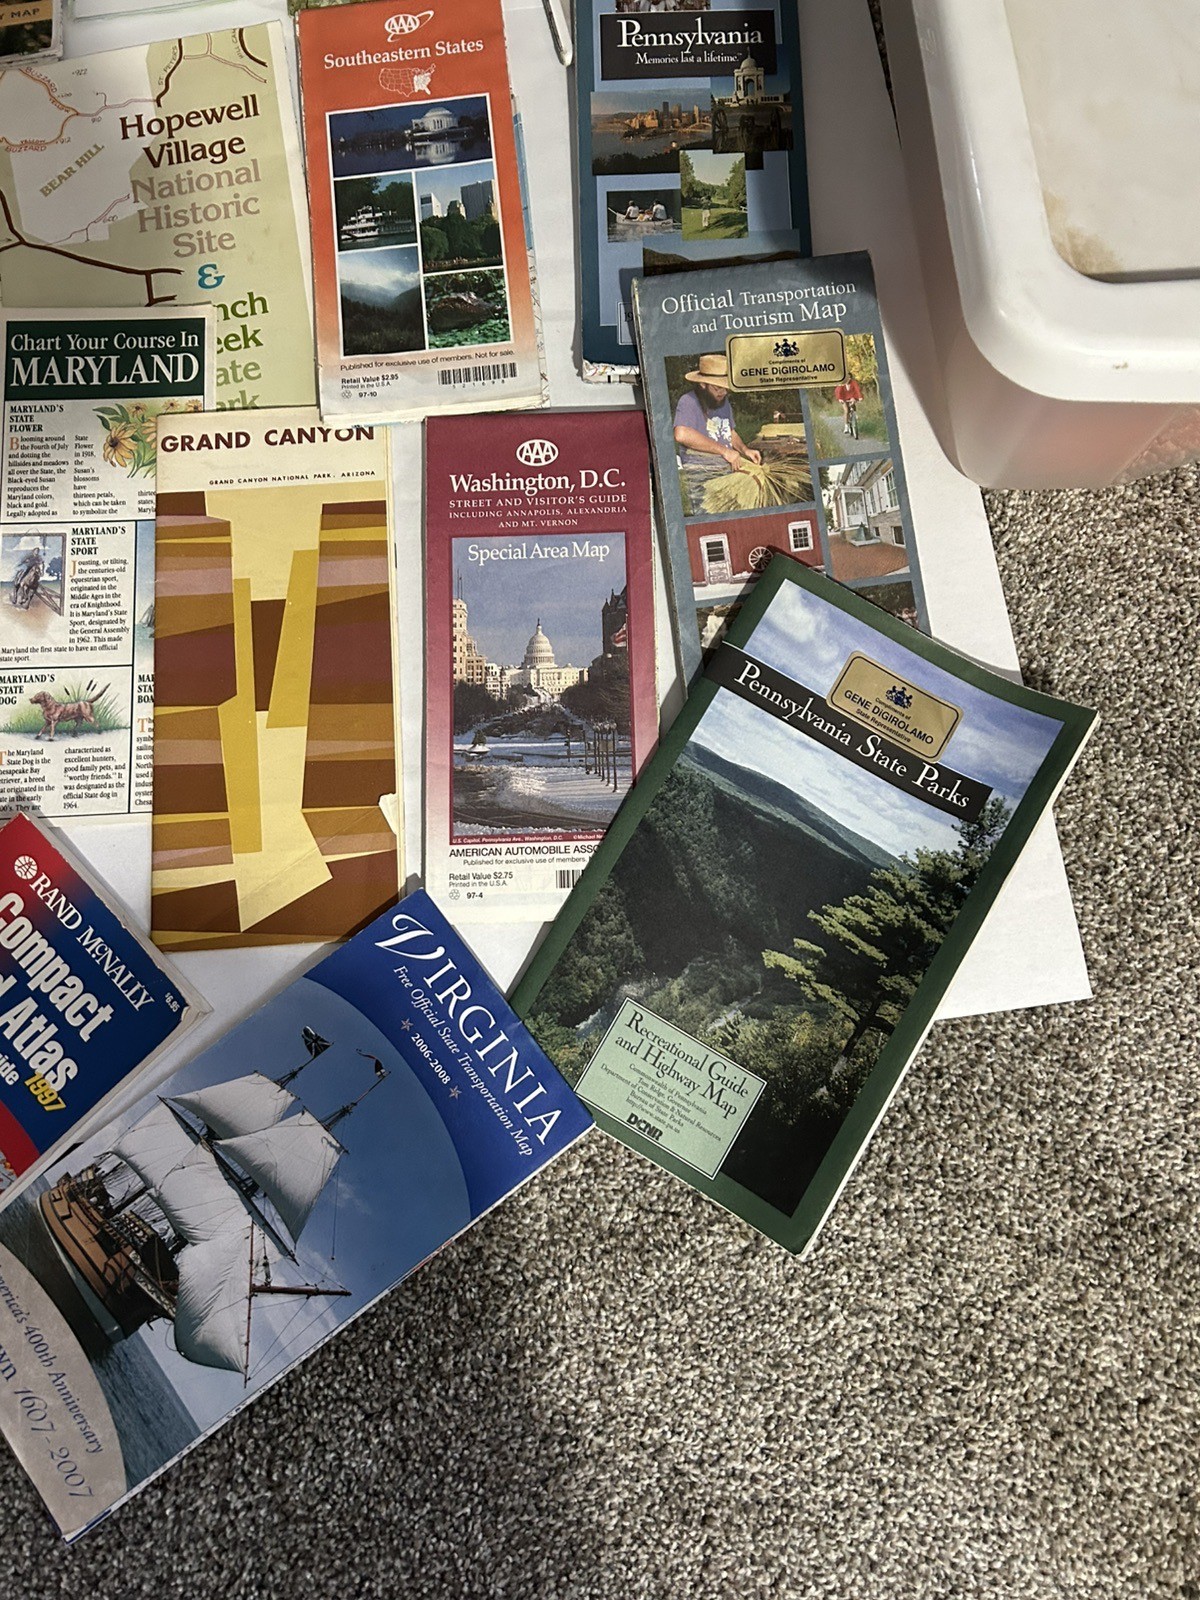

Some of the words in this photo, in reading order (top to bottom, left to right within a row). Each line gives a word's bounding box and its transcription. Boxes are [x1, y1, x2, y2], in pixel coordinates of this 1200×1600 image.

[11, 8, 40, 18] MAP
[617, 17, 763, 53] Pennsylvania
[324, 44, 431, 69] Southeastern
[435, 39, 484, 56] States
[635, 53, 679, 65] Memories
[681, 52, 694, 63] last
[120, 94, 260, 139] Hopewell
[143, 138, 246, 168] Village
[39, 165, 77, 197] BEAR
[75, 142, 104, 169] HILL
[131, 159, 261, 203] National
[138, 193, 260, 232] Historic
[173, 232, 236, 257] Site
[198, 263, 225, 289] &
[661, 290, 735, 314] Official
[739, 282, 857, 306] Transportation
[692, 319, 718, 334] and
[721, 310, 794, 330] Tourism
[799, 300, 847, 323] Map
[10, 334, 62, 351] Chart
[67, 334, 108, 350] Your
[113, 332, 175, 349] Course
[180, 331, 199, 347] In
[10, 352, 200, 387] MARYLAND
[340, 361, 373, 371] Published
[440, 354, 473, 363] members.
[741, 368, 769, 377] GENE
[771, 364, 836, 375] DiGIROLAMO
[362, 375, 379, 383] Value
[381, 373, 399, 381] $2.95
[775, 375, 818, 383] Representative
[9, 415, 35, 423] STATE
[10, 405, 64, 414] MARYLAND'S
[9, 424, 43, 432] FLOWER
[161, 432, 251, 452] GRAND
[264, 427, 374, 445] CANYON
[449, 472, 575, 496] Washington,
[580, 468, 626, 489] D.C.
[449, 500, 492, 508] STREET
[496, 498, 522, 506] AND
[527, 496, 585, 505] VISITOR'S
[589, 494, 627, 503] GUIDE
[449, 510, 503, 518] INCLUDING
[507, 509, 563, 517] ANNAPOLIS,
[567, 506, 627, 514] ALEXANDRIA
[71, 526, 126, 536] MARYLAND'S
[71, 537, 96, 545] STATE
[71, 547, 98, 556] SPORT
[468, 543, 527, 566] Special
[530, 543, 569, 558] Area
[572, 541, 610, 562] Map
[0, 674, 55, 683] MARYLAND'S
[0, 686, 24, 694] STATE
[845, 690, 872, 710] GENE
[872, 706, 934, 744] DiGIROLAMO
[856, 708, 870, 719] State
[871, 717, 911, 742] Representative
[734, 660, 852, 746] Pennsylvania
[856, 735, 907, 777] State
[912, 762, 970, 808] Parks
[449, 848, 502, 857] AMERICAN
[505, 845, 570, 855] AUTOMOBILE
[449, 873, 471, 881] Retail
[493, 872, 513, 880] $2.75
[29, 872, 82, 930] RAND
[76, 926, 155, 1012] McNALLY
[0, 892, 115, 1042] Compact
[165, 992, 180, 1012] $6.95
[374, 913, 562, 1146] VIRGINIA
[0, 996, 78, 1092] Atlas
[625, 1009, 708, 1072] Recreational
[708, 1061, 749, 1098] Guide
[393, 965, 414, 988] Free
[410, 988, 445, 1028] Official
[437, 1027, 461, 1054] State
[457, 1052, 513, 1129] Transportation
[510, 1128, 533, 1156] Map
[411, 1033, 451, 1085] 2006-2008
[24, 1070, 67, 1112] 1997
[615, 1036, 643, 1055] and
[641, 1043, 701, 1096] Highway
[701, 1080, 737, 1119] Map
[627, 1113, 663, 1141] DCNR
[24, 1325, 57, 1368] 400th
[48, 1372, 103, 1454] Anniversary
